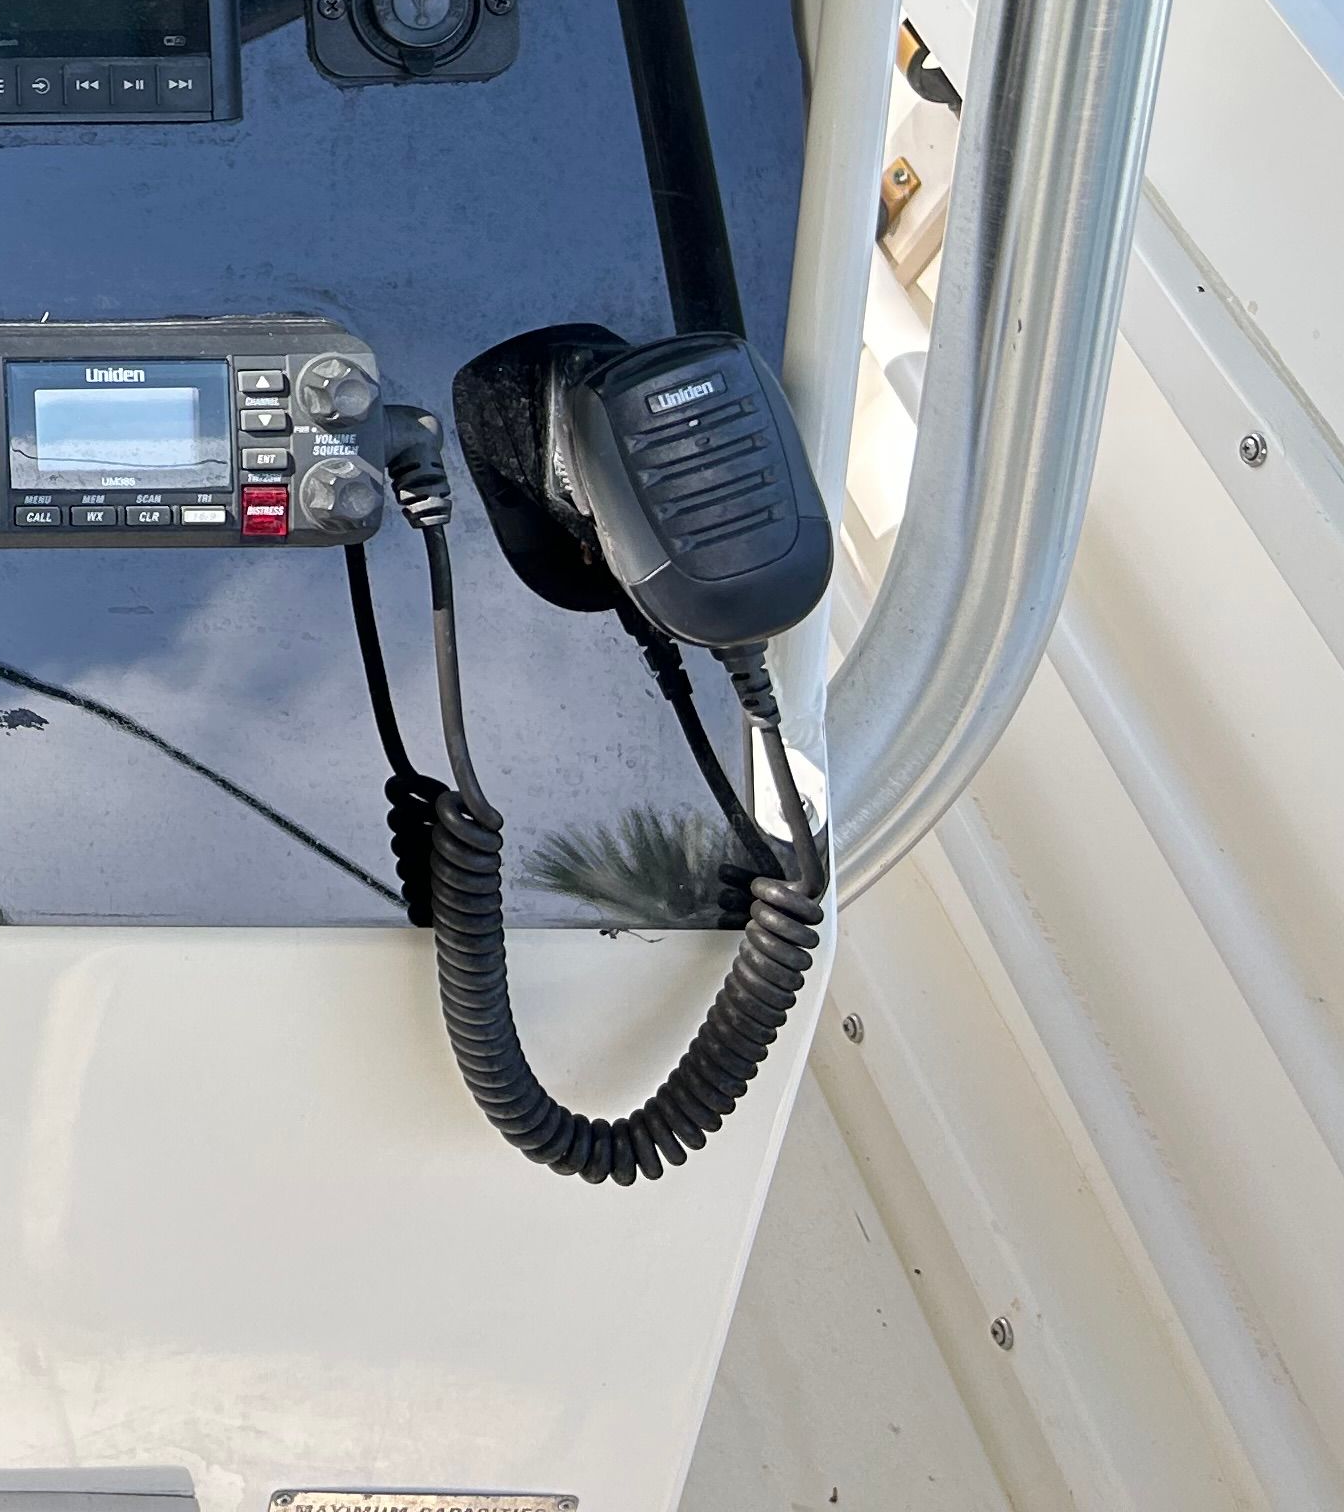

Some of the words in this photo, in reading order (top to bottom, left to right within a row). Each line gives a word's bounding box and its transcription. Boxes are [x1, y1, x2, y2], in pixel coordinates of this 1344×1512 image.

[85, 367, 146, 383] Uniden
[658, 380, 714, 409] Uniden
[314, 433, 357, 445] VOLUME
[312, 445, 360, 456] SQUELCH
[257, 454, 276, 465] ENT
[24, 495, 52, 505] MENU
[81, 494, 105, 504] MEM
[135, 494, 162, 504] SCAN
[197, 494, 212, 504] TRI
[246, 505, 285, 516] DISTRESS
[26, 511, 53, 522] CALL
[86, 511, 104, 522] WX
[138, 511, 160, 522] CLR
